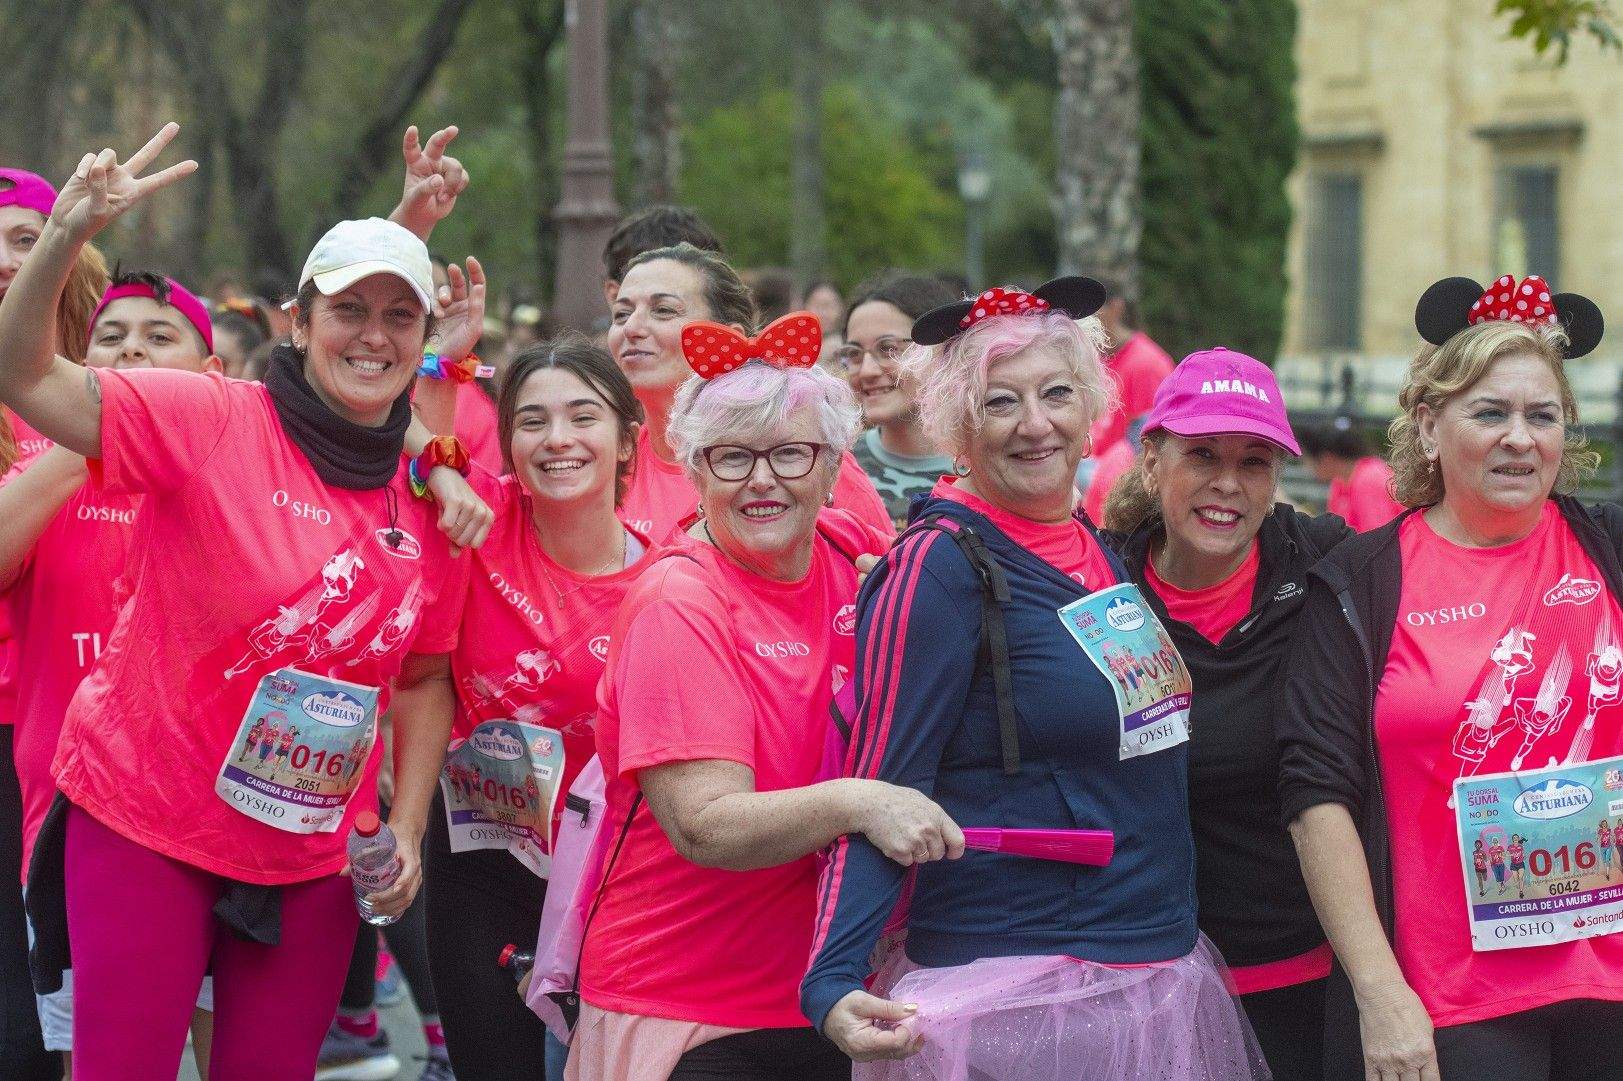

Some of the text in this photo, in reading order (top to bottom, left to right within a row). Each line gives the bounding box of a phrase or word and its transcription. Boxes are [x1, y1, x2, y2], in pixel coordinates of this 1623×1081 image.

[77, 504, 136, 525] OYSHO
[272, 489, 331, 526] OSHO
[489, 572, 544, 625] OYSHO
[1406, 602, 1487, 626] OYSHO
[755, 641, 810, 658] OYSHO
[1139, 649, 1174, 680] 016
[305, 697, 362, 723] ASTURIANA
[290, 744, 345, 777] 016
[245, 776, 281, 796] CARRERA
[283, 789, 292, 799] DE
[292, 792, 303, 801] LA
[303, 794, 324, 805] MUJER
[294, 777, 321, 792] 2051
[483, 779, 527, 810] 016
[232, 788, 286, 819] OYSHO
[1467, 794, 1500, 807] SUMA
[1519, 793, 1589, 814] ASTURIANA
[1528, 841, 1597, 877] 016
[1549, 880, 1580, 896] 6042
[1498, 901, 1539, 915] CARRERA
[1540, 902, 1552, 910] DE
[1554, 900, 1565, 909] LA
[1566, 893, 1593, 907] MUJER
[1494, 921, 1555, 940] OYSHO
